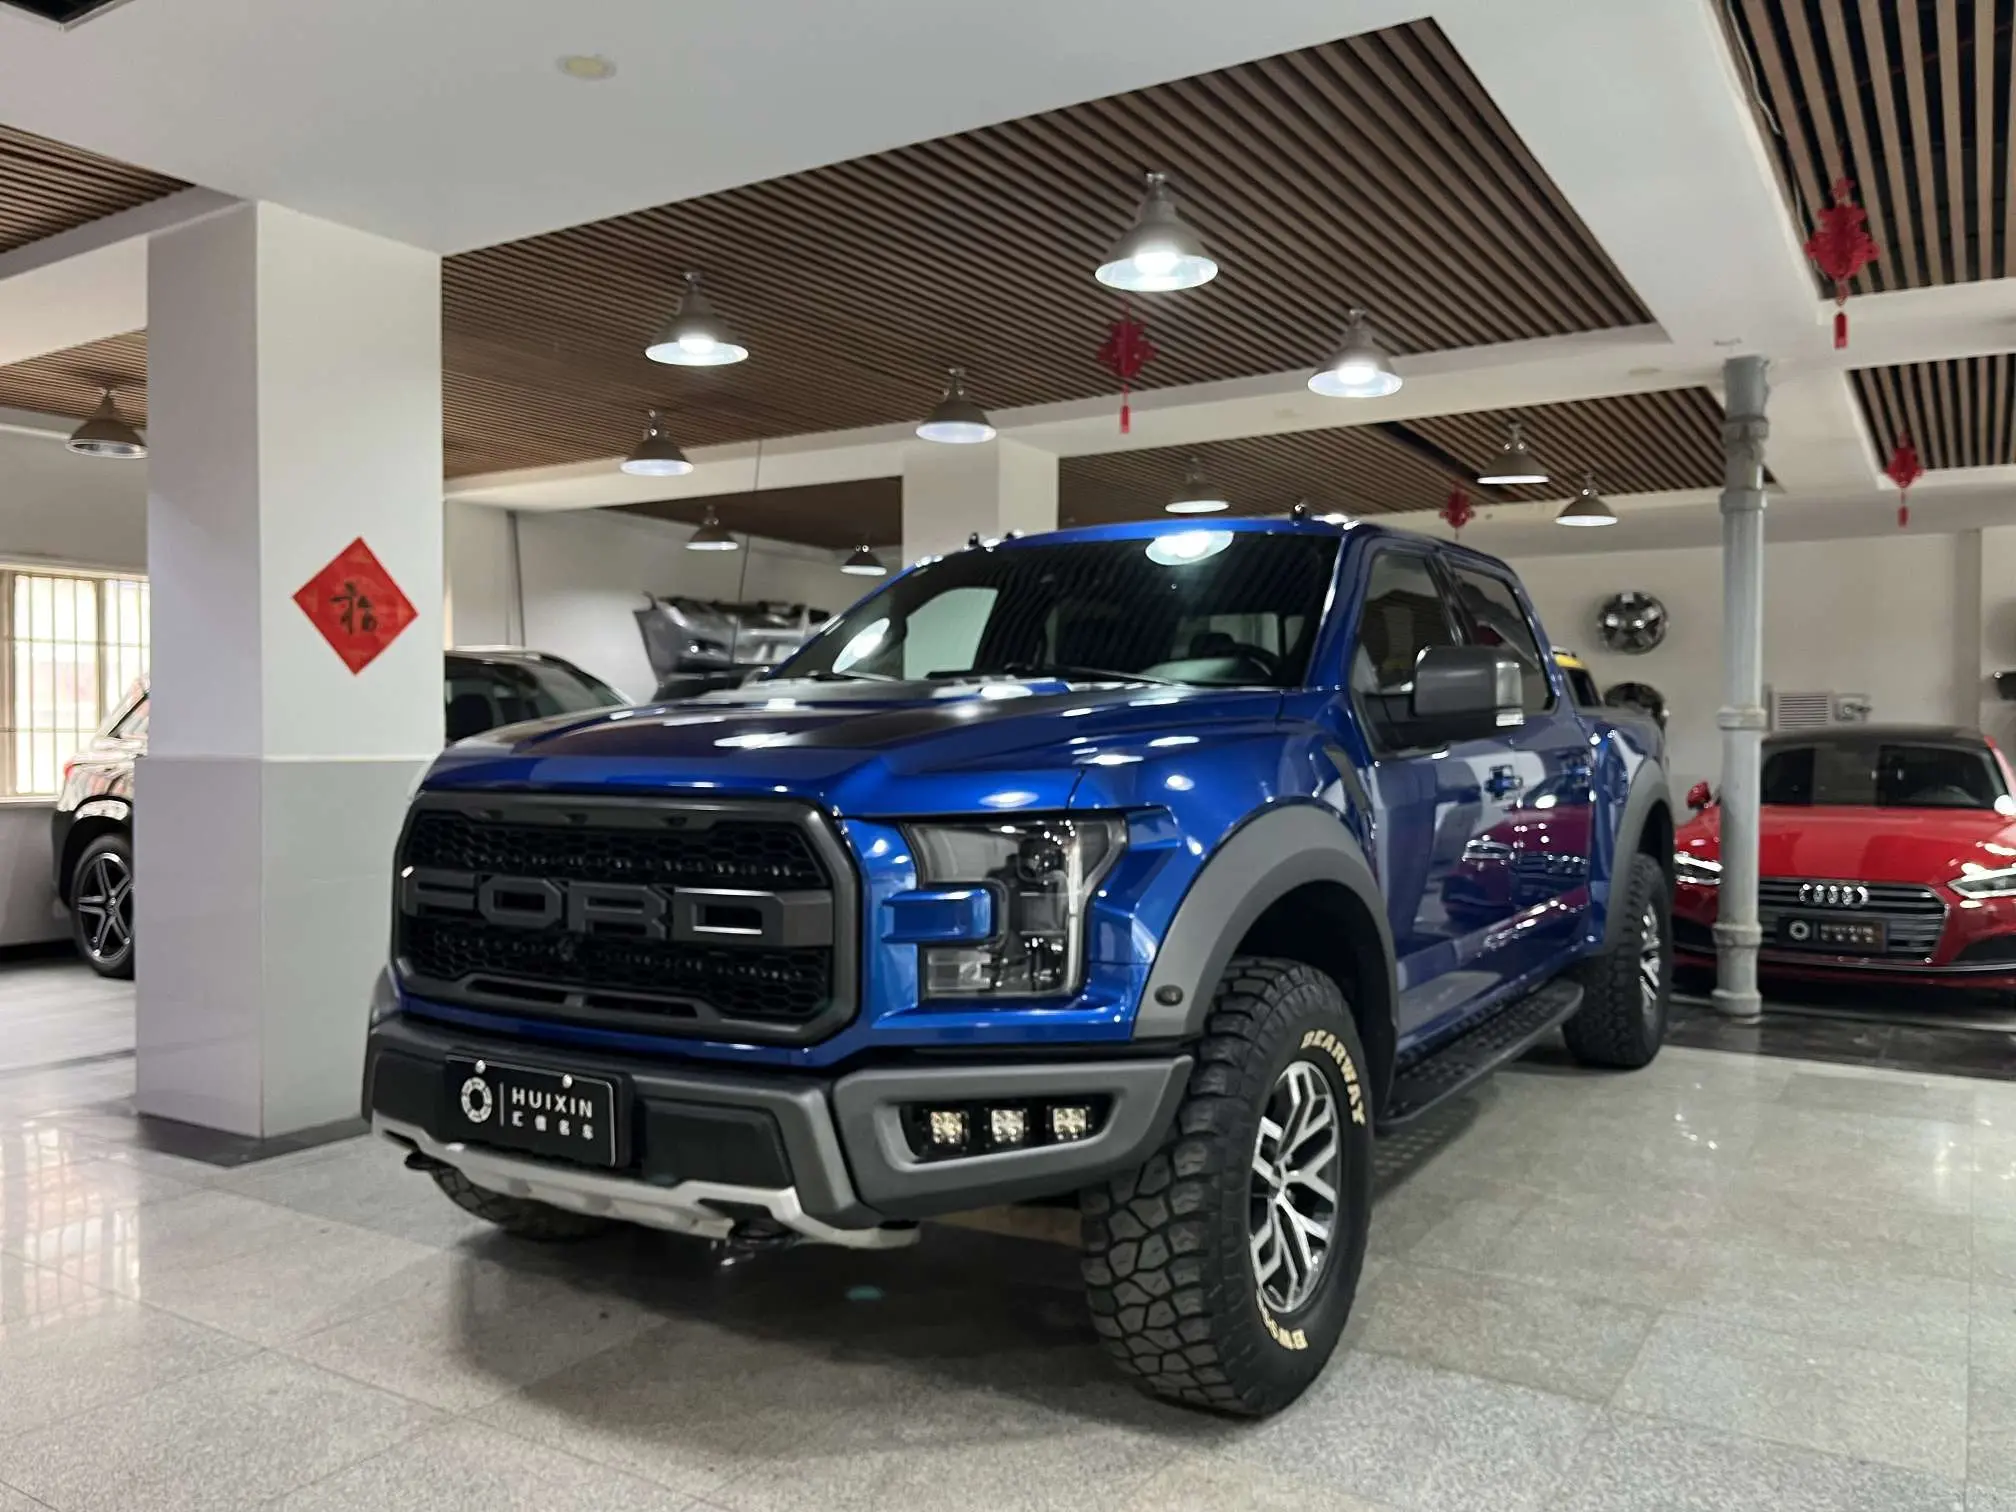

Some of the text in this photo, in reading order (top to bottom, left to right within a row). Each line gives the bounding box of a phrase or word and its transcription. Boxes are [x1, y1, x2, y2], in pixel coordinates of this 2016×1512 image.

[328, 581, 379, 637] 福
[401, 866, 785, 946] FORD
[511, 1086, 593, 1119] HUIXIN
